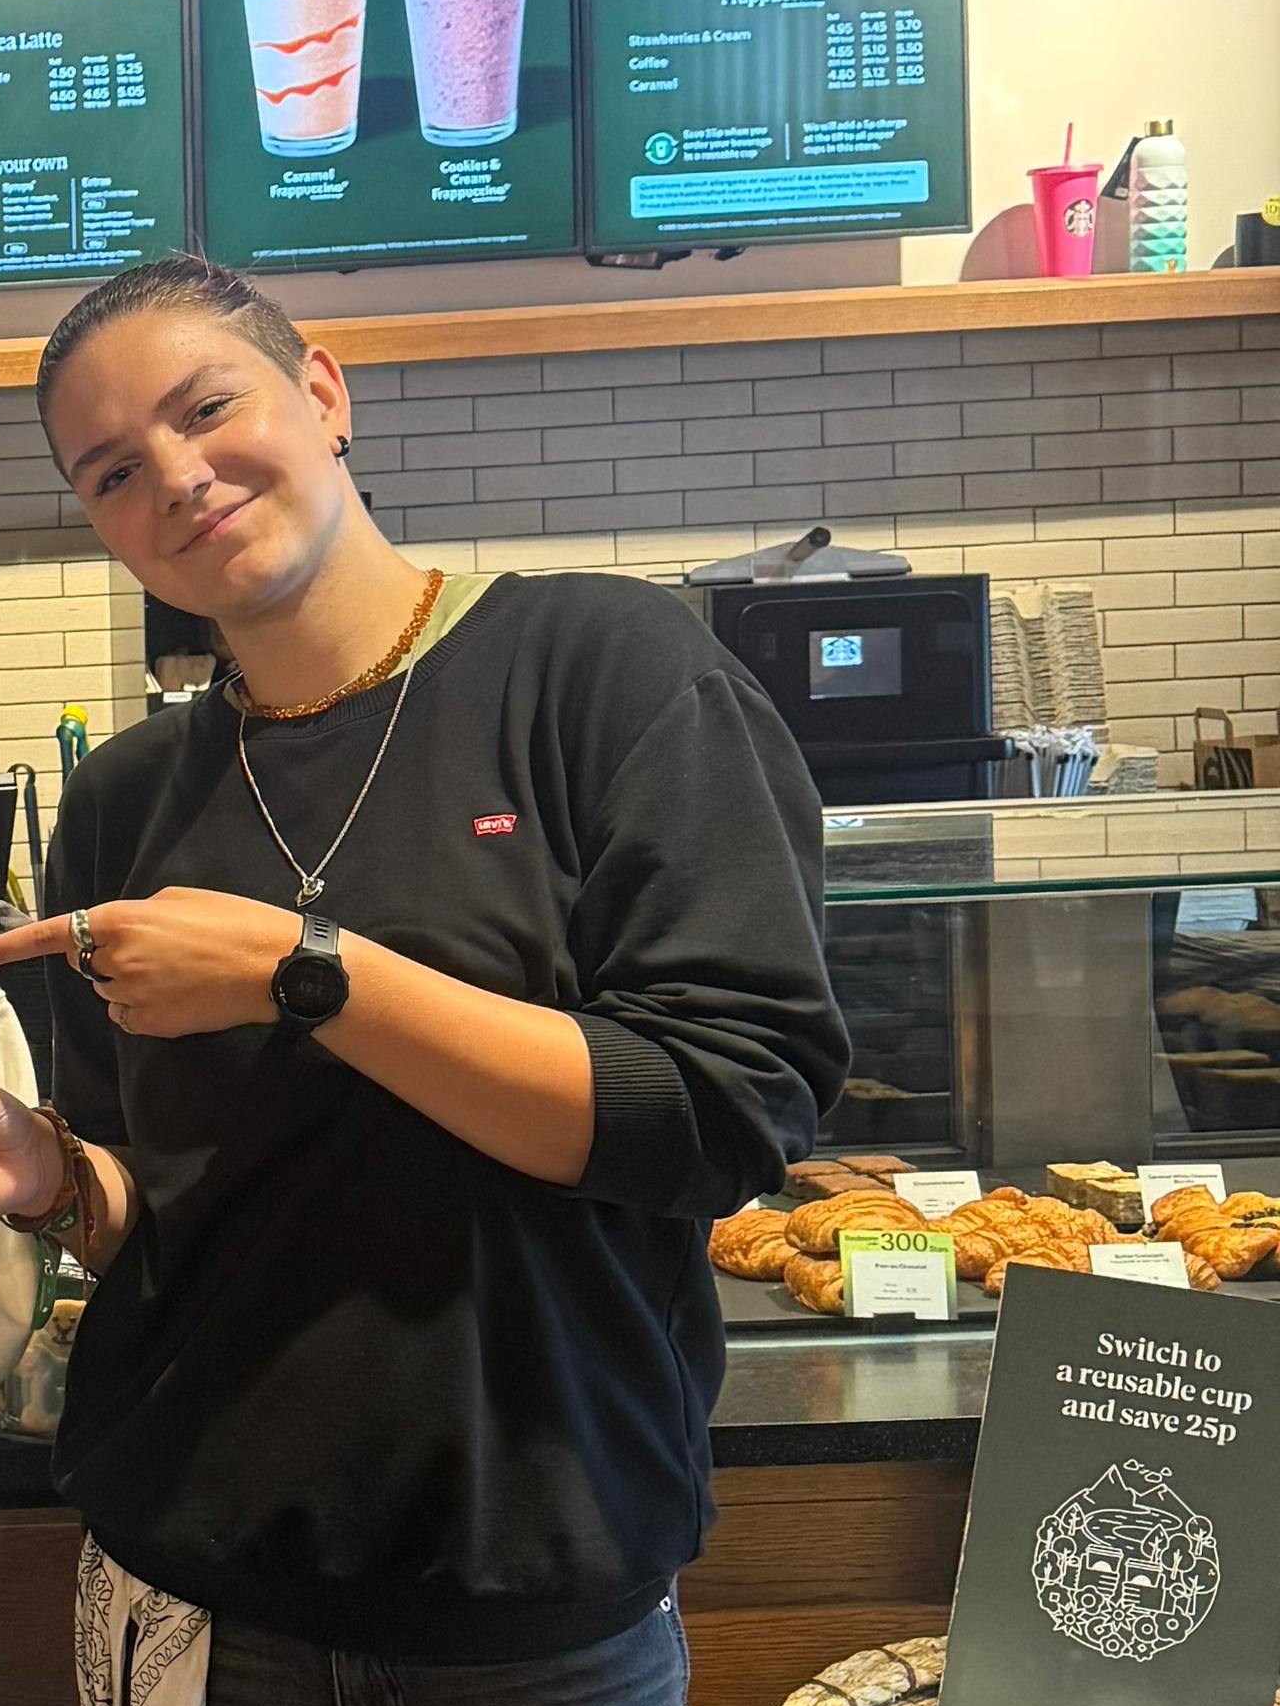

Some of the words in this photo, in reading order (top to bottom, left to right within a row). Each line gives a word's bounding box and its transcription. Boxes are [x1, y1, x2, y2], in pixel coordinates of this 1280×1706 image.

[18, 31, 63, 51] Latte
[628, 31, 701, 48] Strawberries
[712, 29, 752, 43] Cream
[628, 56, 670, 71] Coffee
[628, 77, 679, 93] Caramel
[32, 156, 69, 172] own
[439, 159, 488, 174] Cookies
[282, 167, 336, 183] Caramel
[449, 173, 492, 186] Cream
[880, 1232, 928, 1252] 300
[1096, 1332, 1188, 1368] Switch
[1194, 1348, 1222, 1372] to
[1056, 1363, 1073, 1382] a
[1078, 1366, 1196, 1402] reusable
[1201, 1387, 1253, 1415] cup
[1061, 1398, 1116, 1422] and
[1119, 1407, 1180, 1433] save
[1184, 1414, 1237, 1446] 25p
